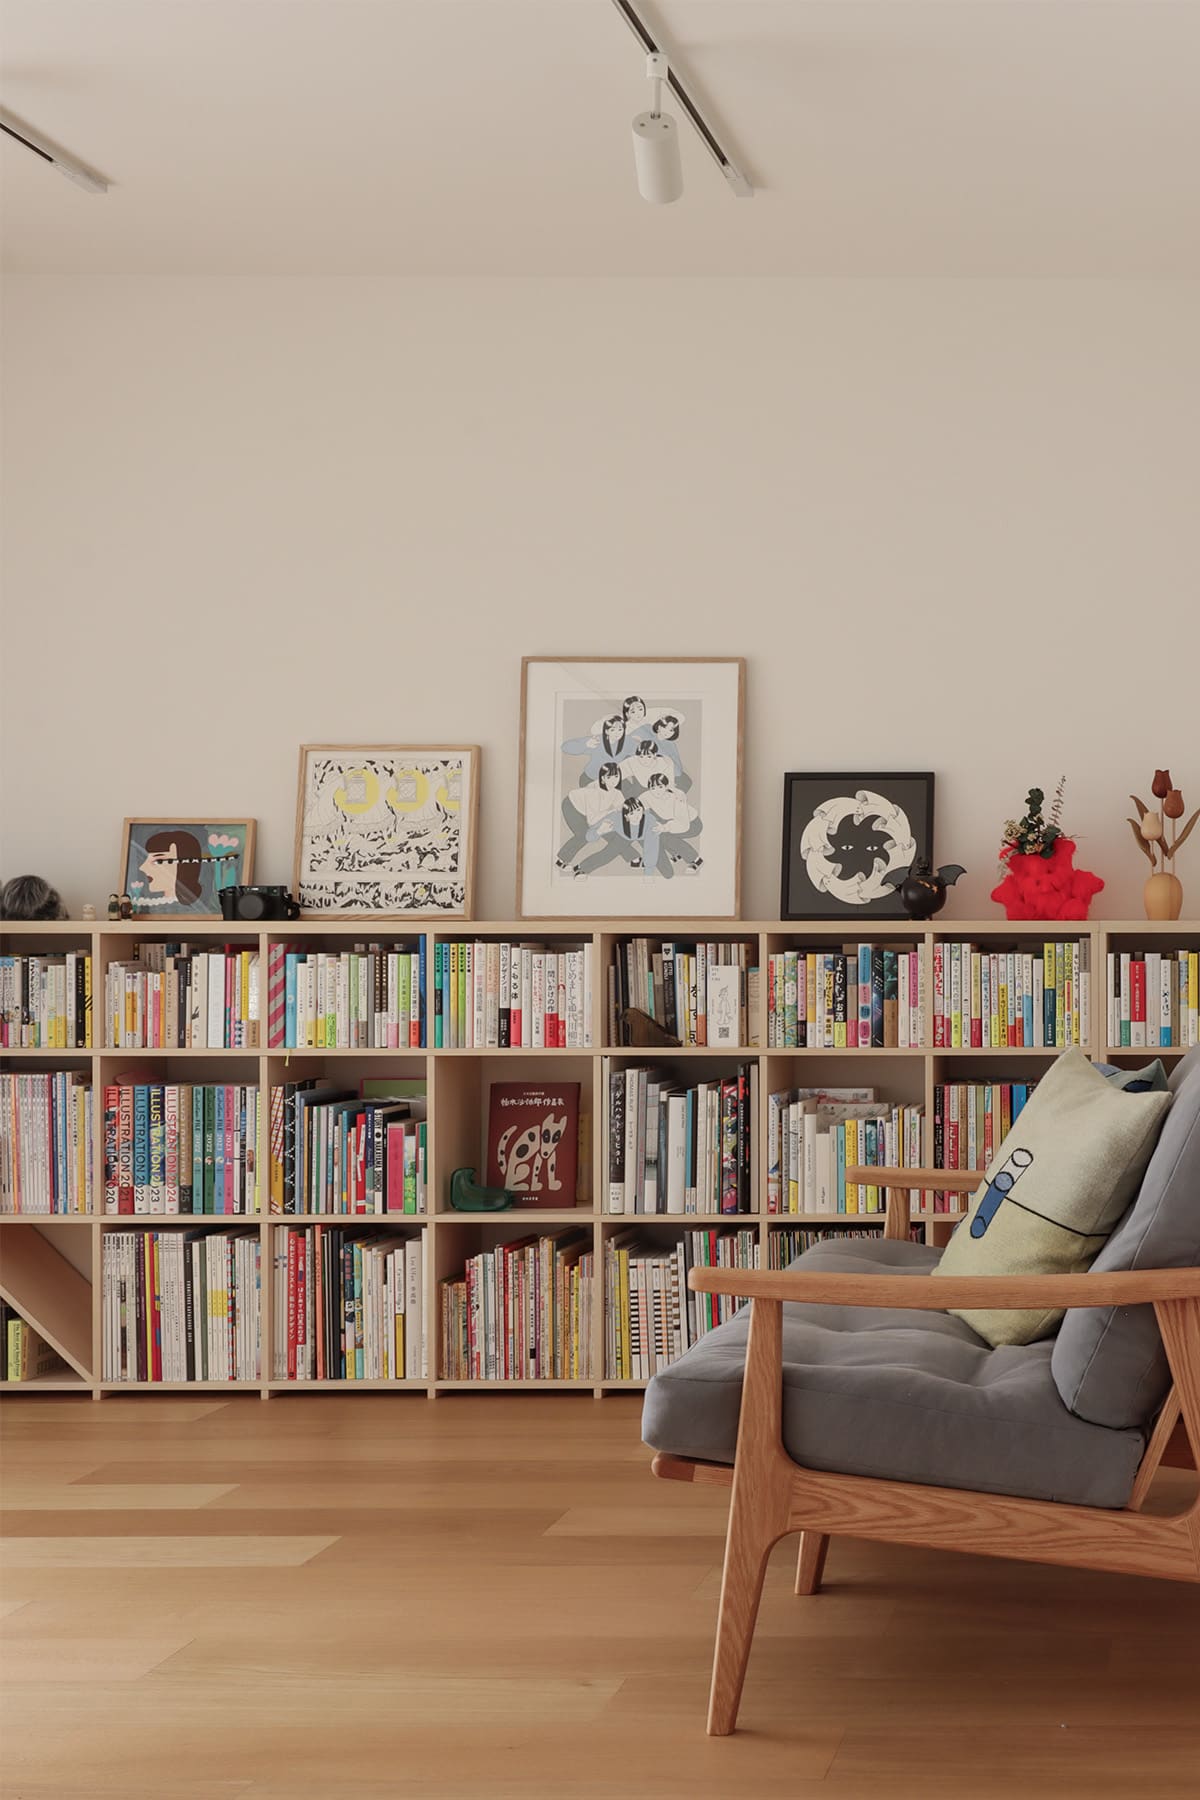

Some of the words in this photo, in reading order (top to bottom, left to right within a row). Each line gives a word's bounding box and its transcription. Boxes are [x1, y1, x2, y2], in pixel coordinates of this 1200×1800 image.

[120, 1088, 131, 1172] ILLUSTRATION
[135, 1088, 146, 1172] ILLUSTRATION
[151, 1088, 161, 1172] ILLUSTRATION
[167, 1088, 177, 1172] ILLUSTRATION
[614, 1090, 624, 1165] ゲルハルト・リヒター
[105, 1175, 116, 1204] 2020
[120, 1175, 131, 1201] 2021
[135, 1175, 146, 1202] 2022
[151, 1175, 161, 1202] 2023
[167, 1175, 177, 1202] 2024
